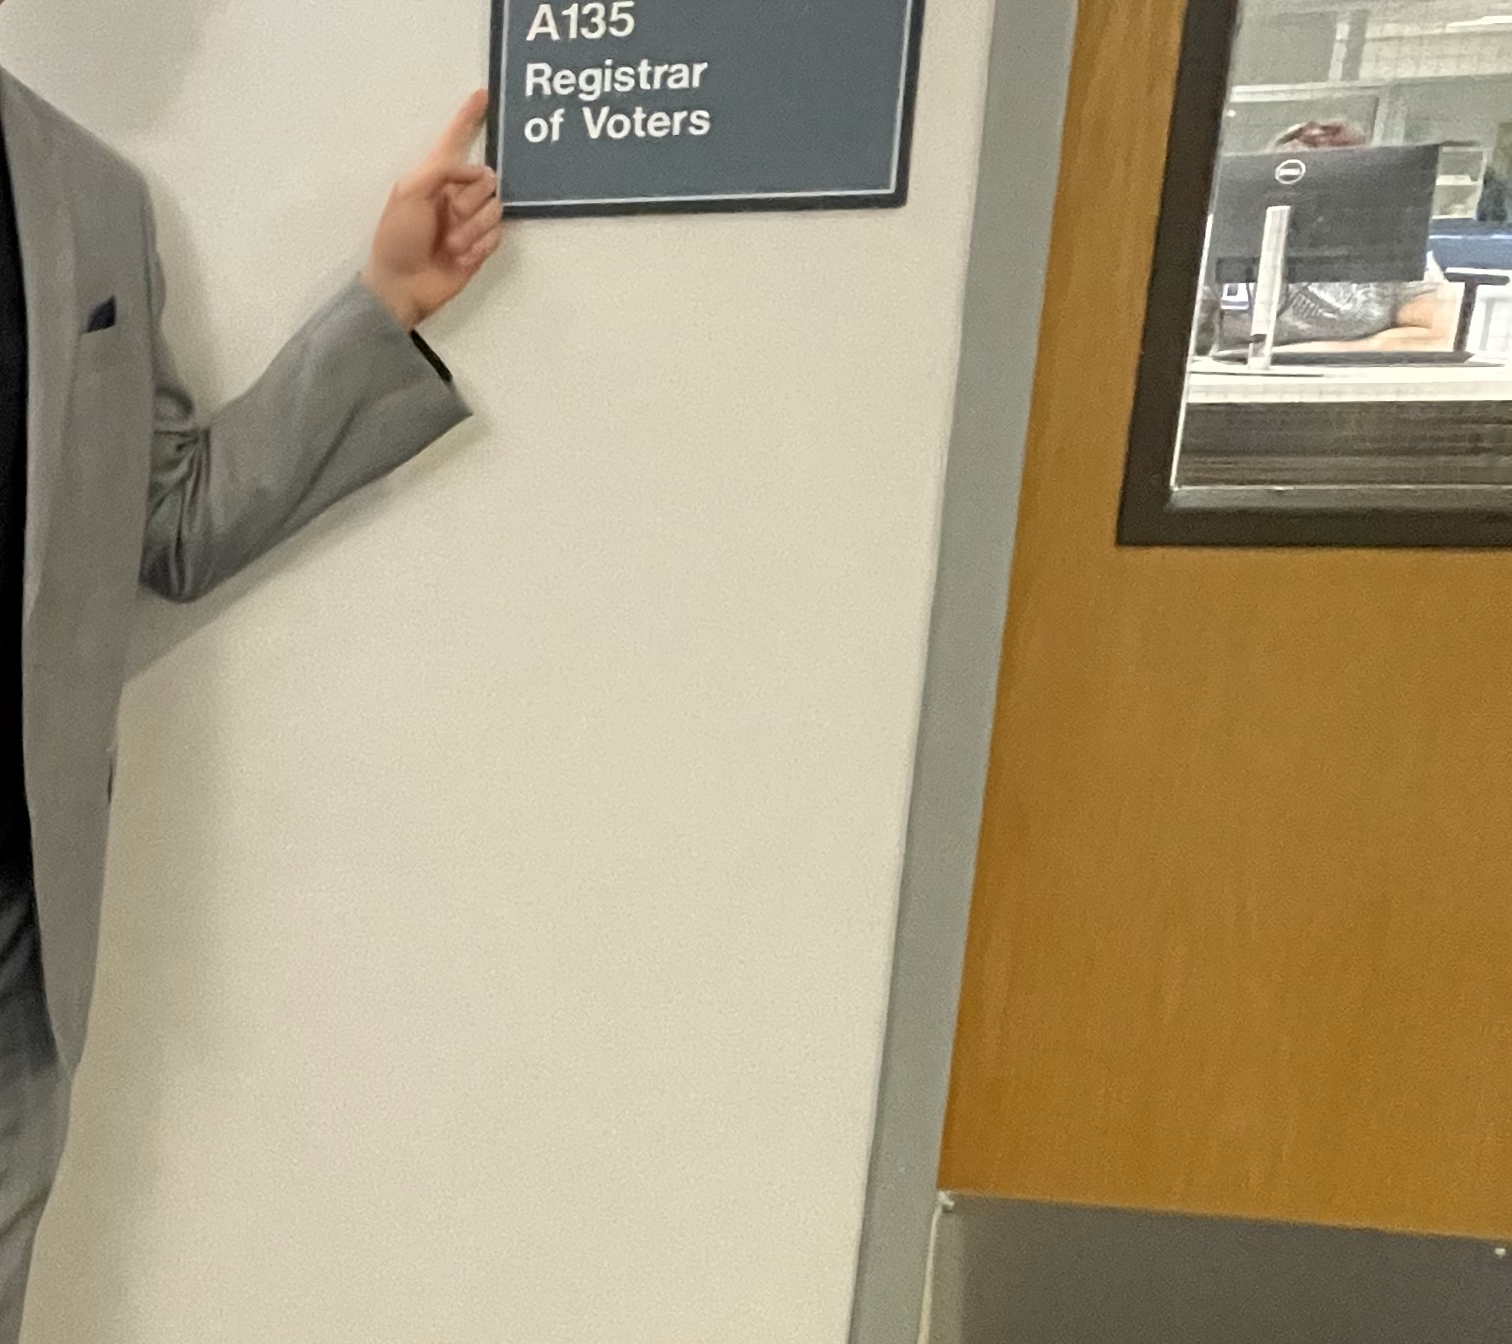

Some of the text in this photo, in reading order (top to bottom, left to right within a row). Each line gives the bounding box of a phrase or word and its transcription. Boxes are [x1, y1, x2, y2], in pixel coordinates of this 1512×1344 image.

[525, 0, 636, 42] A135
[524, 58, 709, 102] Registrar
[523, 105, 712, 143] of Voters
